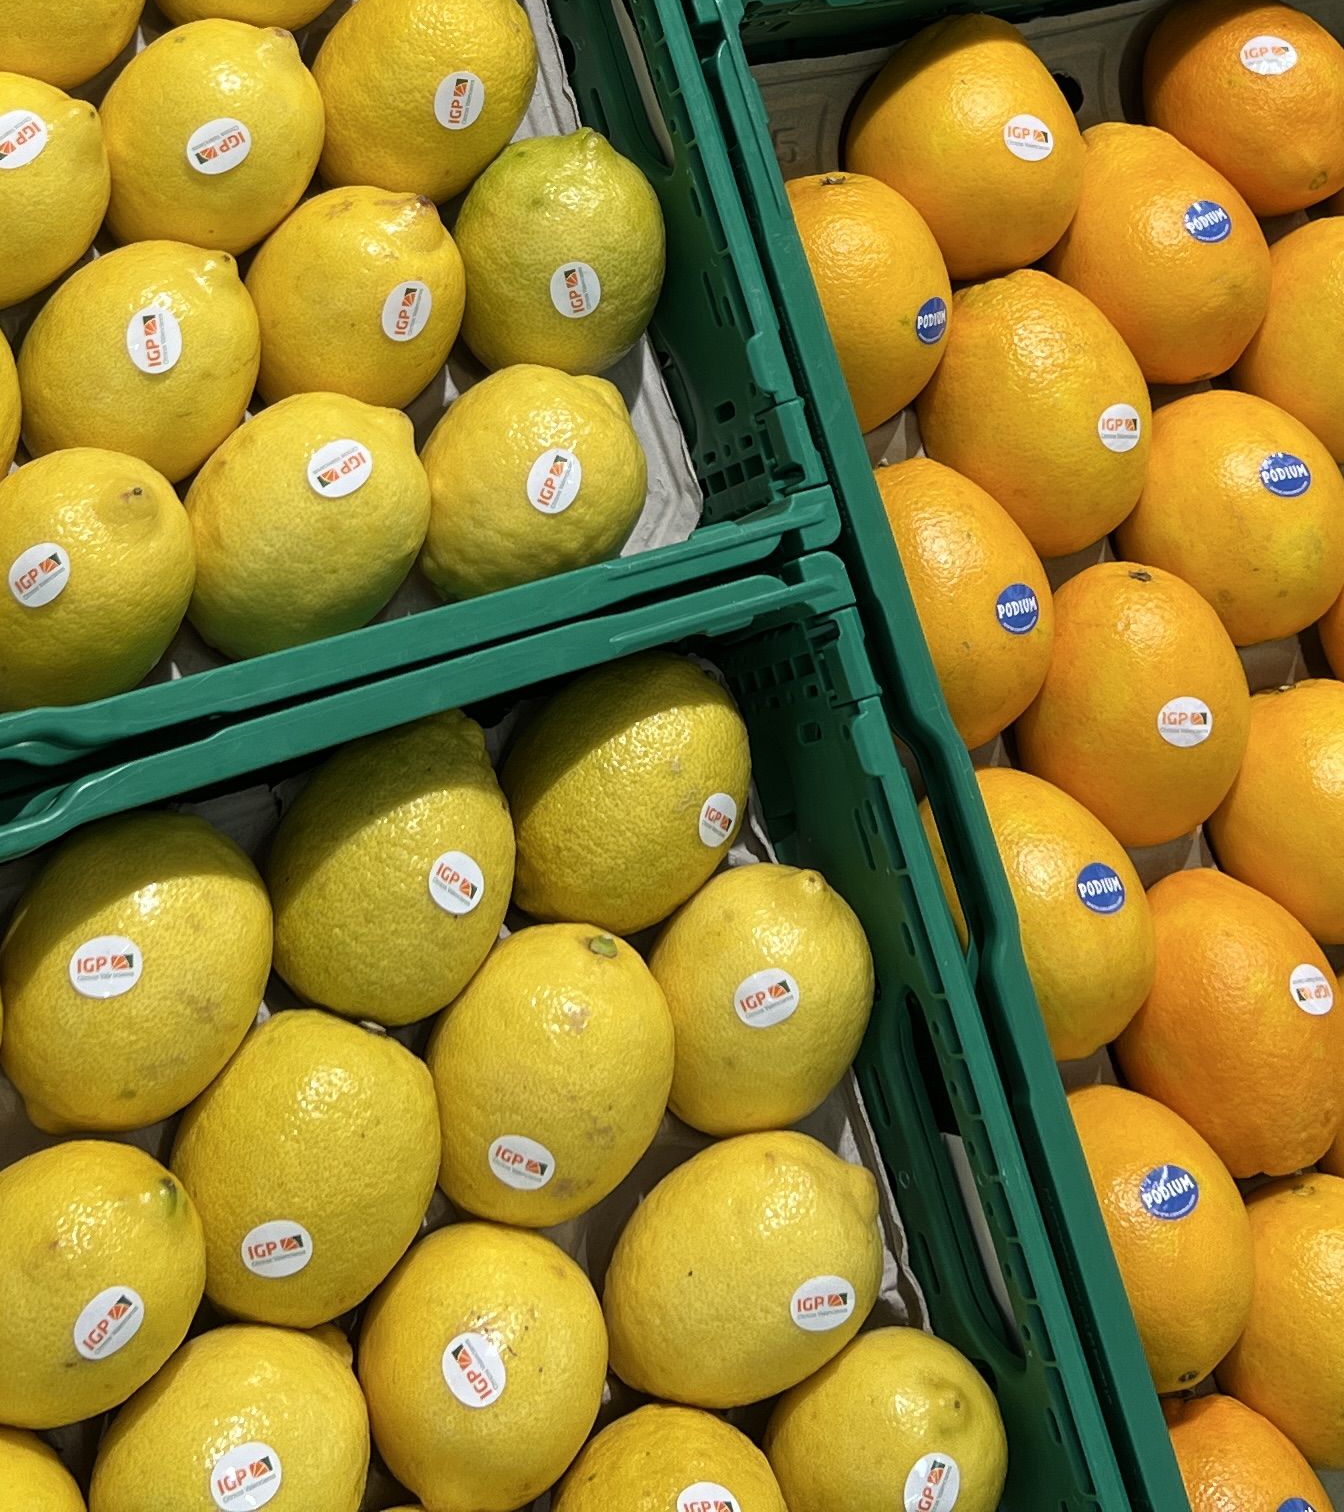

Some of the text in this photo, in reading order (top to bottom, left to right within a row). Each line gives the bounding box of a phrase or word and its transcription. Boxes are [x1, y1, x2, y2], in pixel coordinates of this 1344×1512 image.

[448, 99, 463, 125] IGP
[17, 122, 41, 147] IGP
[1185, 209, 1228, 233] PODIUM
[395, 309, 411, 337] IGP
[916, 309, 946, 330] PODIUM
[1101, 418, 1122, 432] IGP
[340, 452, 367, 476] IGP
[1260, 463, 1308, 485] PODIUM
[537, 478, 557, 507] IGP
[14, 568, 40, 593] IGP
[996, 596, 1038, 618] PODIUM
[1161, 712, 1185, 726] IGP
[1076, 876, 1121, 898] PODIUM
[77, 956, 109, 974] IGP
[741, 992, 768, 1012] IGP
[1144, 1173, 1194, 1209] PODIUM
[249, 1242, 278, 1260] IGP
[797, 1297, 826, 1313] IGP
